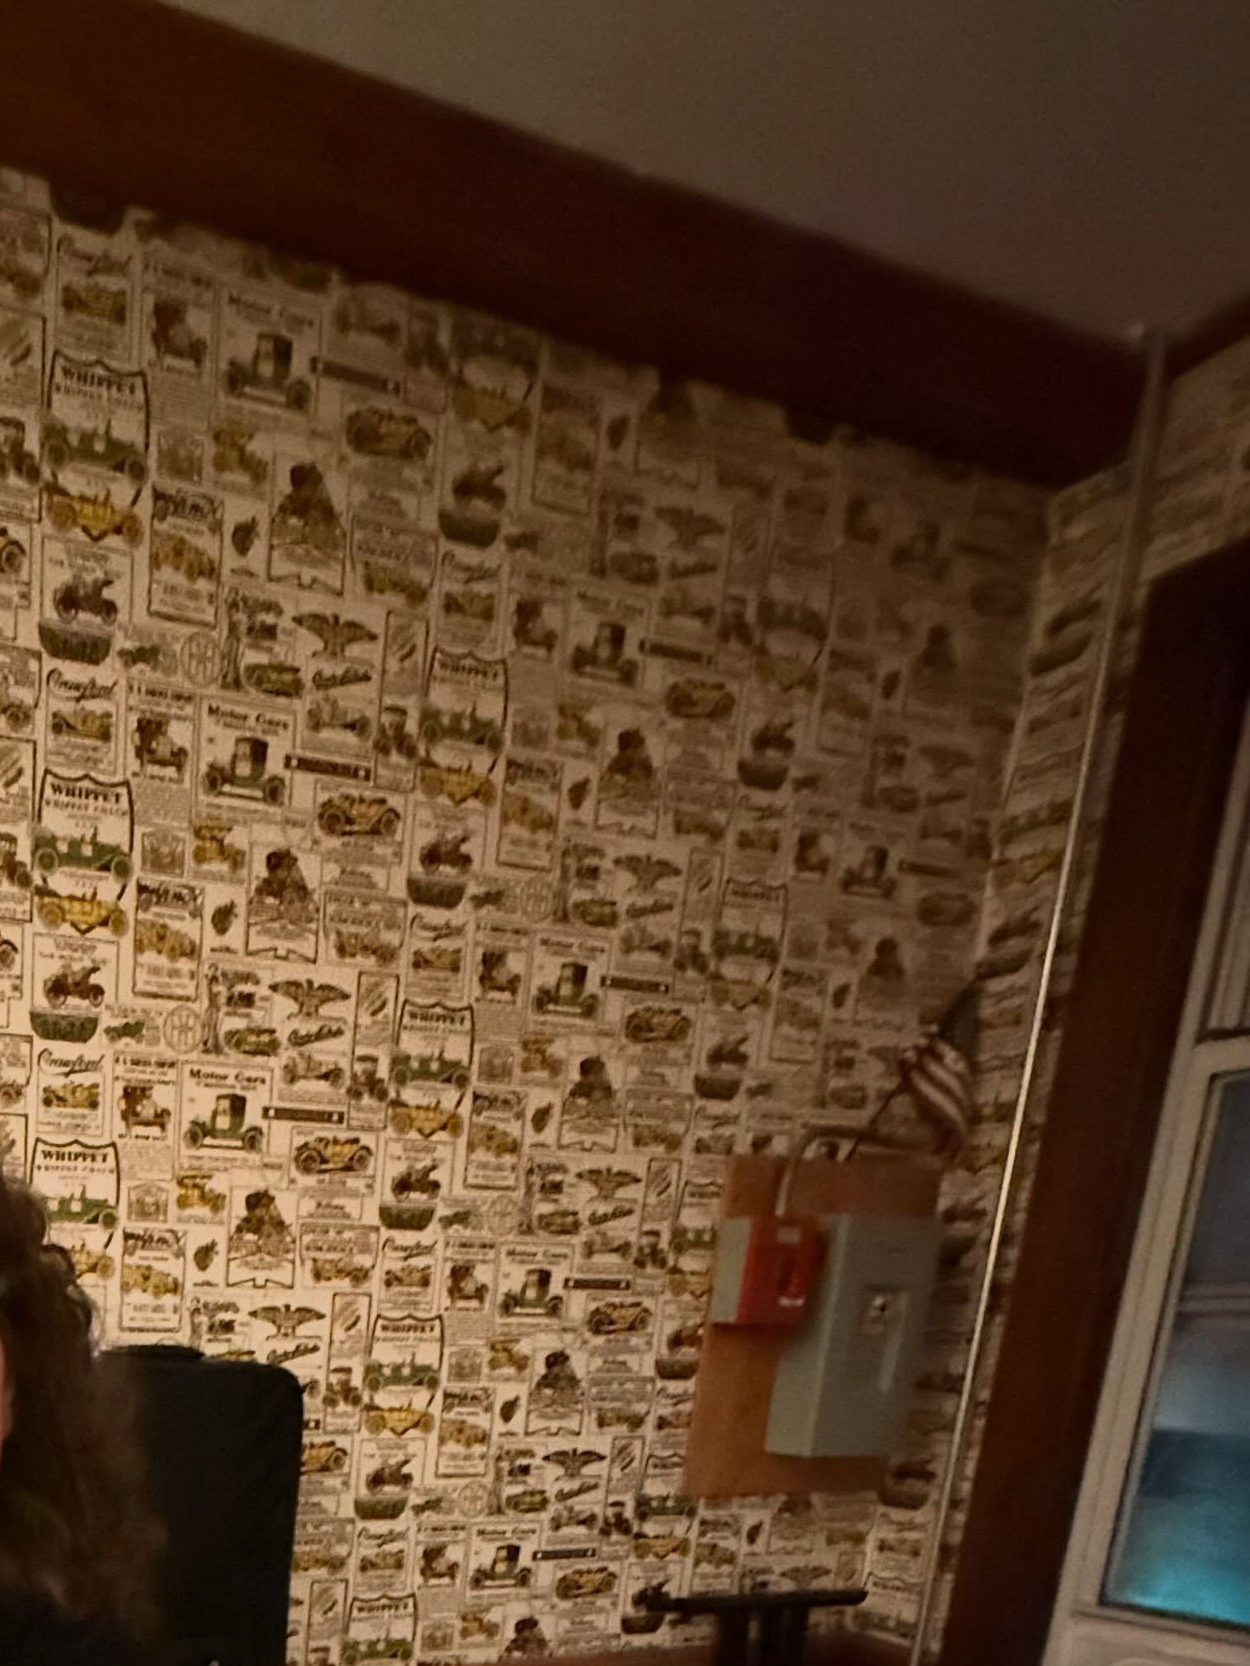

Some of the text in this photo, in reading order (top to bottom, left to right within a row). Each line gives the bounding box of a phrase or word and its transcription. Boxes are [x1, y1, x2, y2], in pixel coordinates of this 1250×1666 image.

[46, 668, 118, 702] Crawford
[36, 1048, 103, 1078] Crawford
[41, 1149, 108, 1163] WHIPPET
